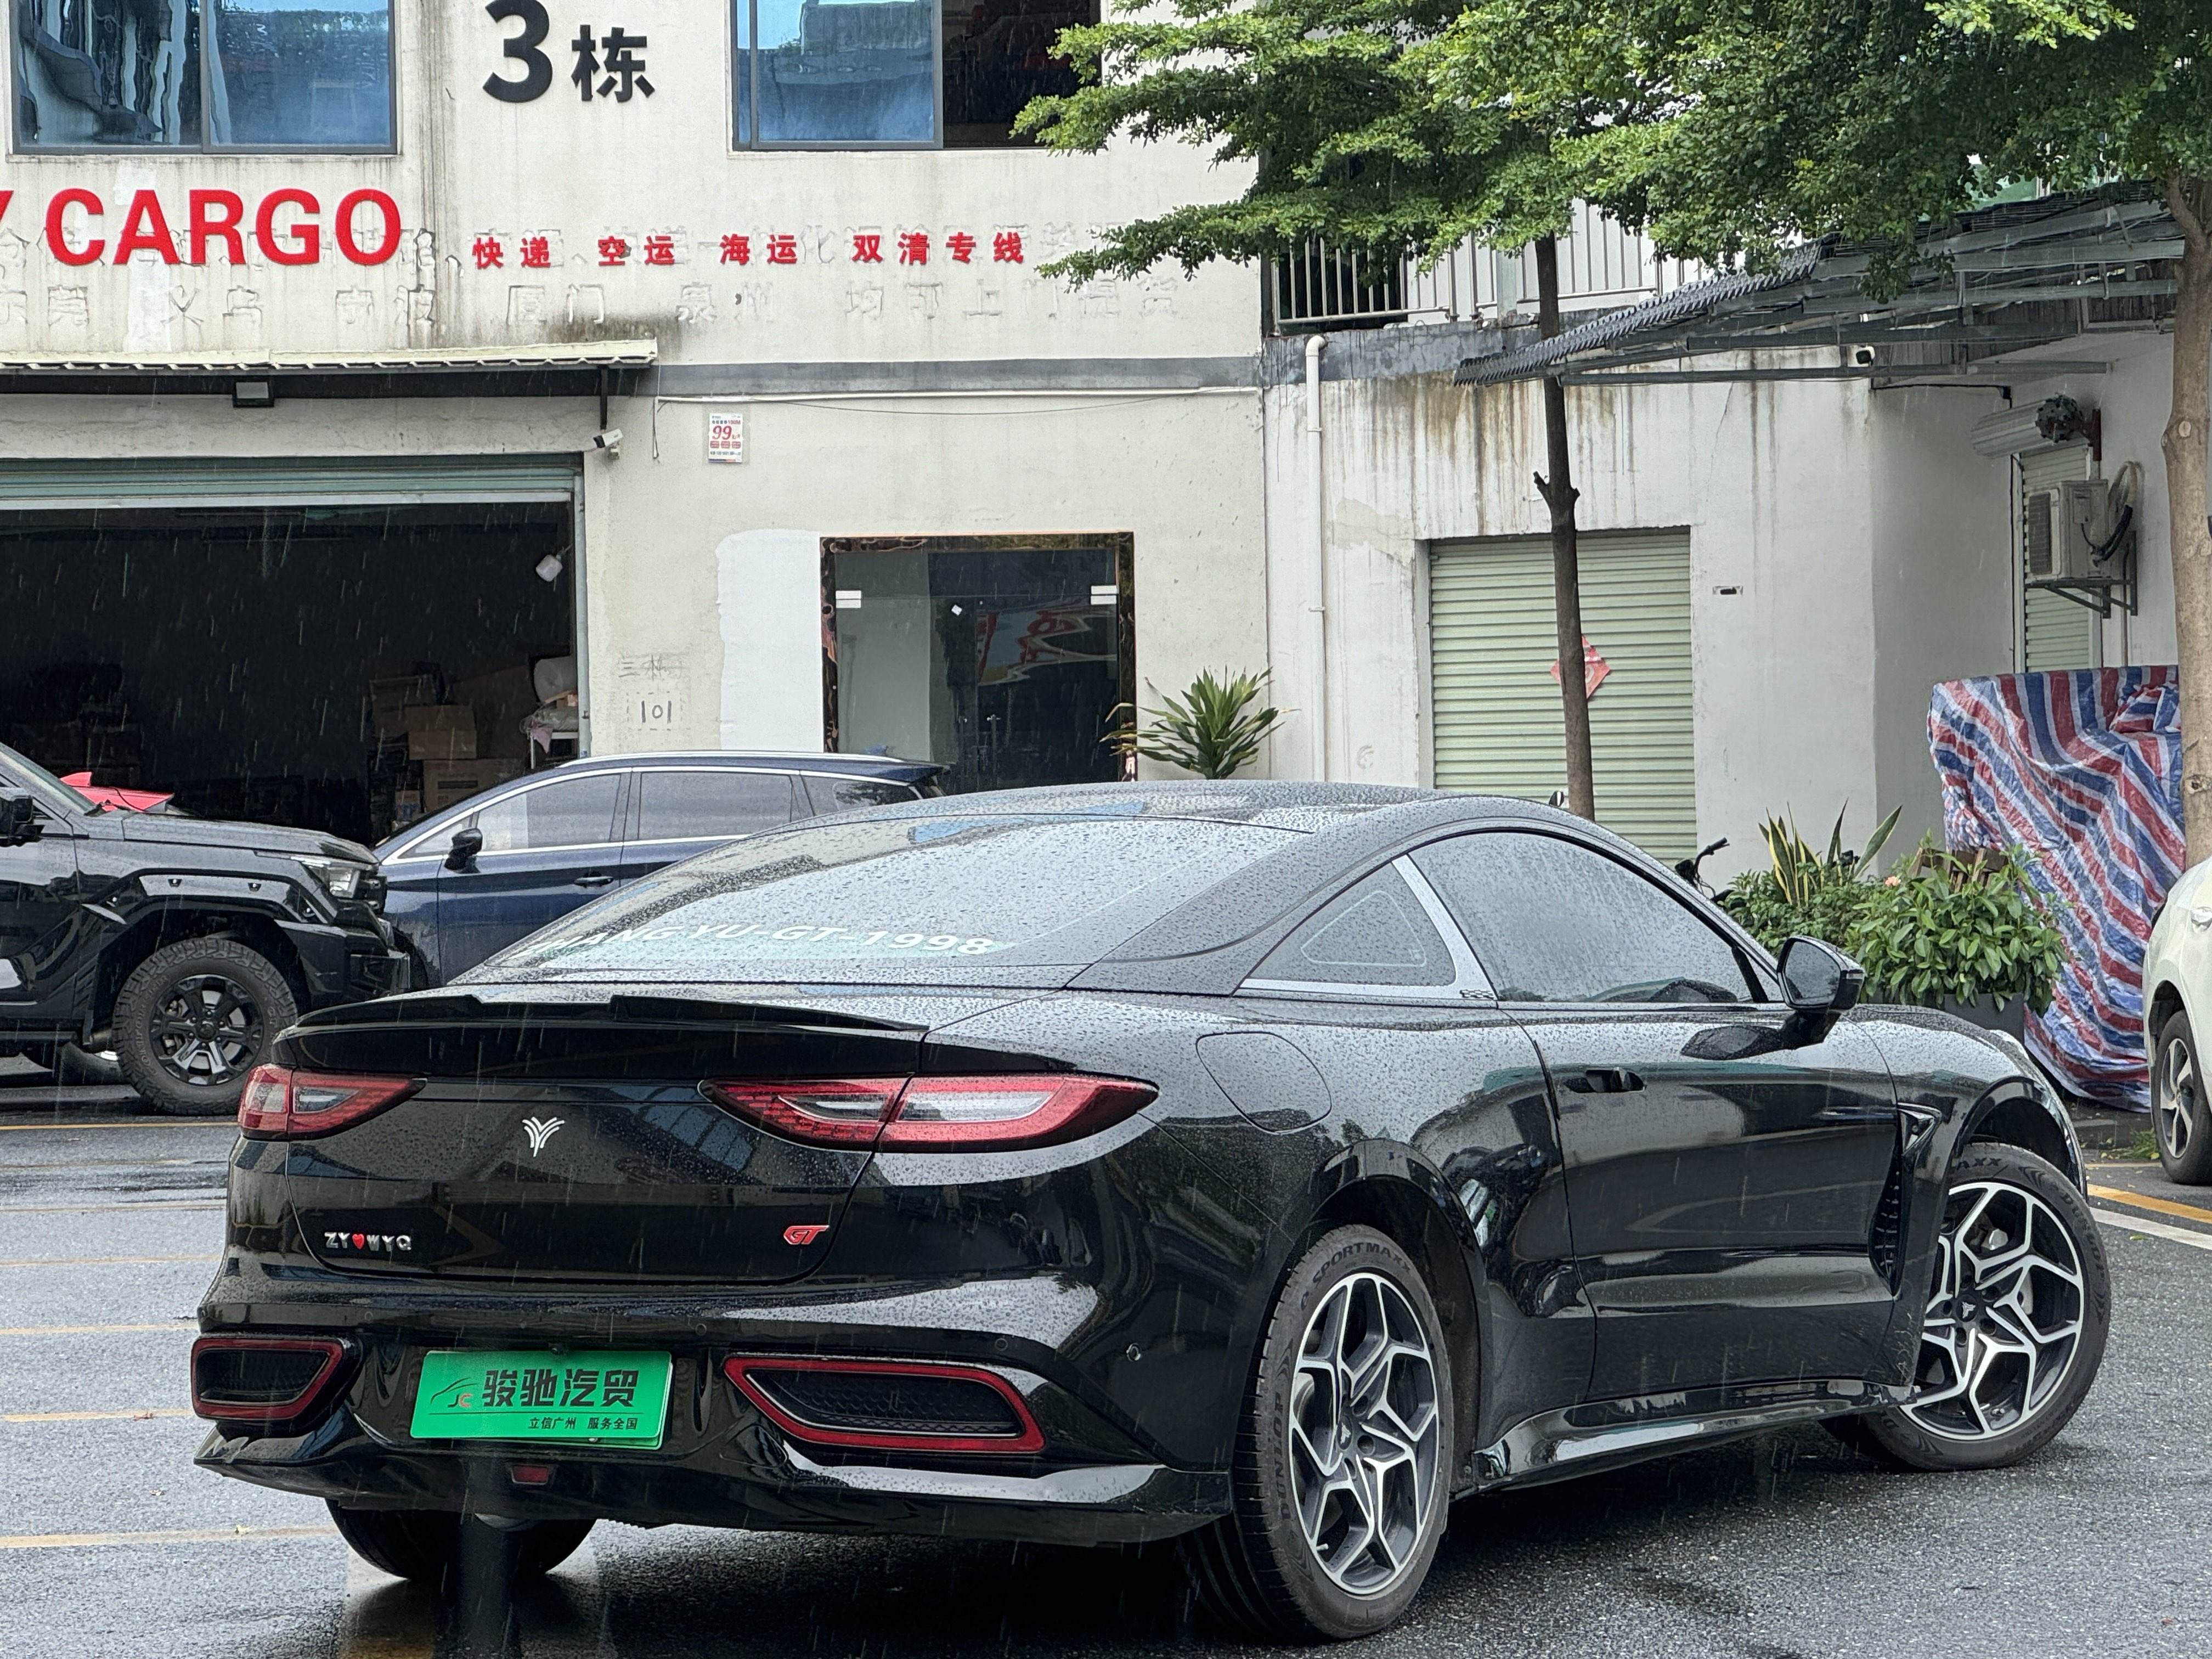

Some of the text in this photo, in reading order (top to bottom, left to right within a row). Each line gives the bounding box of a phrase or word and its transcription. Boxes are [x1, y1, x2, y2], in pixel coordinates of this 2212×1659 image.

[483, 0, 655, 103] 3栋
[46, 188, 401, 266] CARGO
[472, 236, 551, 269] 快递
[598, 235, 675, 266] 空运
[720, 234, 797, 266] 海运
[851, 232, 1024, 264] 双清专线
[712, 425, 732, 440] 99
[641, 700, 672, 724] 101
[783, 1225, 830, 1245] GT
[482, 1369, 640, 1408] 骏驰汽贸
[527, 1417, 639, 1430] 立信广州 服务全国
[1273, 1391, 1290, 1520] DUNLOP
